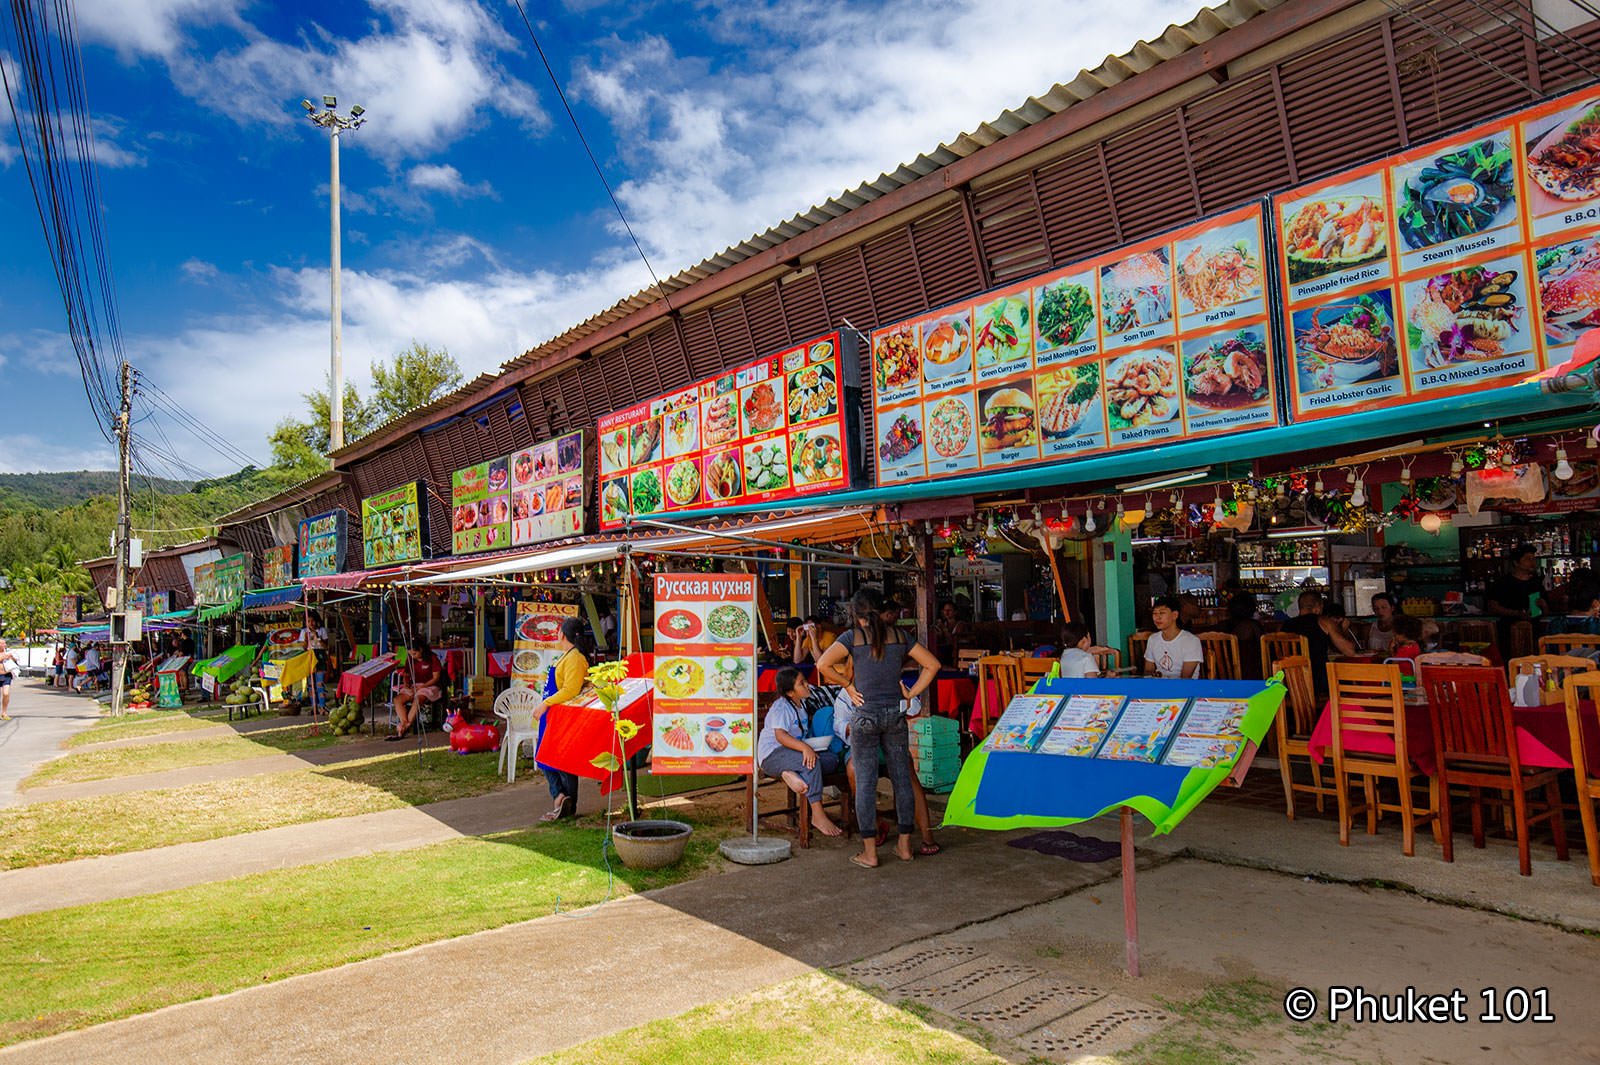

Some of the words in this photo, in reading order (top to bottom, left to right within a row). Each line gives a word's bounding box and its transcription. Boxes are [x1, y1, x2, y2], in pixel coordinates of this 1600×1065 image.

[1564, 208, 1597, 224] B.B.Q
[1422, 248, 1454, 262] Steam
[1455, 236, 1496, 254] Mussels
[1297, 279, 1339, 296] Pineapple
[1339, 272, 1360, 285] fried
[1361, 268, 1380, 279] Rice
[1205, 311, 1220, 322] Pad
[1220, 308, 1236, 319] Thai
[1123, 333, 1139, 343] Som
[1139, 329, 1155, 339] Tum
[1037, 354, 1053, 364] Fried
[1052, 349, 1079, 361] Morning
[1079, 344, 1097, 353] Glory
[981, 369, 998, 378] Green
[997, 365, 1012, 373] Curry
[1013, 361, 1028, 370] soup
[1421, 373, 1448, 386] B.B.Q
[1449, 366, 1480, 380] Mixed
[1481, 358, 1526, 374] Seafood
[930, 383, 941, 391] Tom
[942, 380, 954, 389] yum
[953, 376, 967, 385] soup
[881, 395, 893, 403] Fried
[892, 389, 917, 400] Cashewnut
[1310, 394, 1331, 406] Fried
[1332, 389, 1365, 402] Lobster
[1365, 383, 1392, 396] Garlic
[600, 416, 615, 429] ANNY
[615, 406, 647, 424] RESTURANT
[1190, 421, 1205, 429] Fried
[1205, 418, 1223, 427] Prawn
[1223, 414, 1251, 425] Tamarind
[1251, 411, 1270, 420] Sauce
[1121, 427, 1143, 440] Baked
[1143, 425, 1170, 437] Prawns
[1053, 442, 1077, 451] Salmon
[1077, 438, 1095, 447] Steak
[1000, 451, 1020, 460] Burger
[656, 576, 710, 600] Русская
[711, 580, 752, 600] кухня
[520, 602, 576, 615] КВАС
